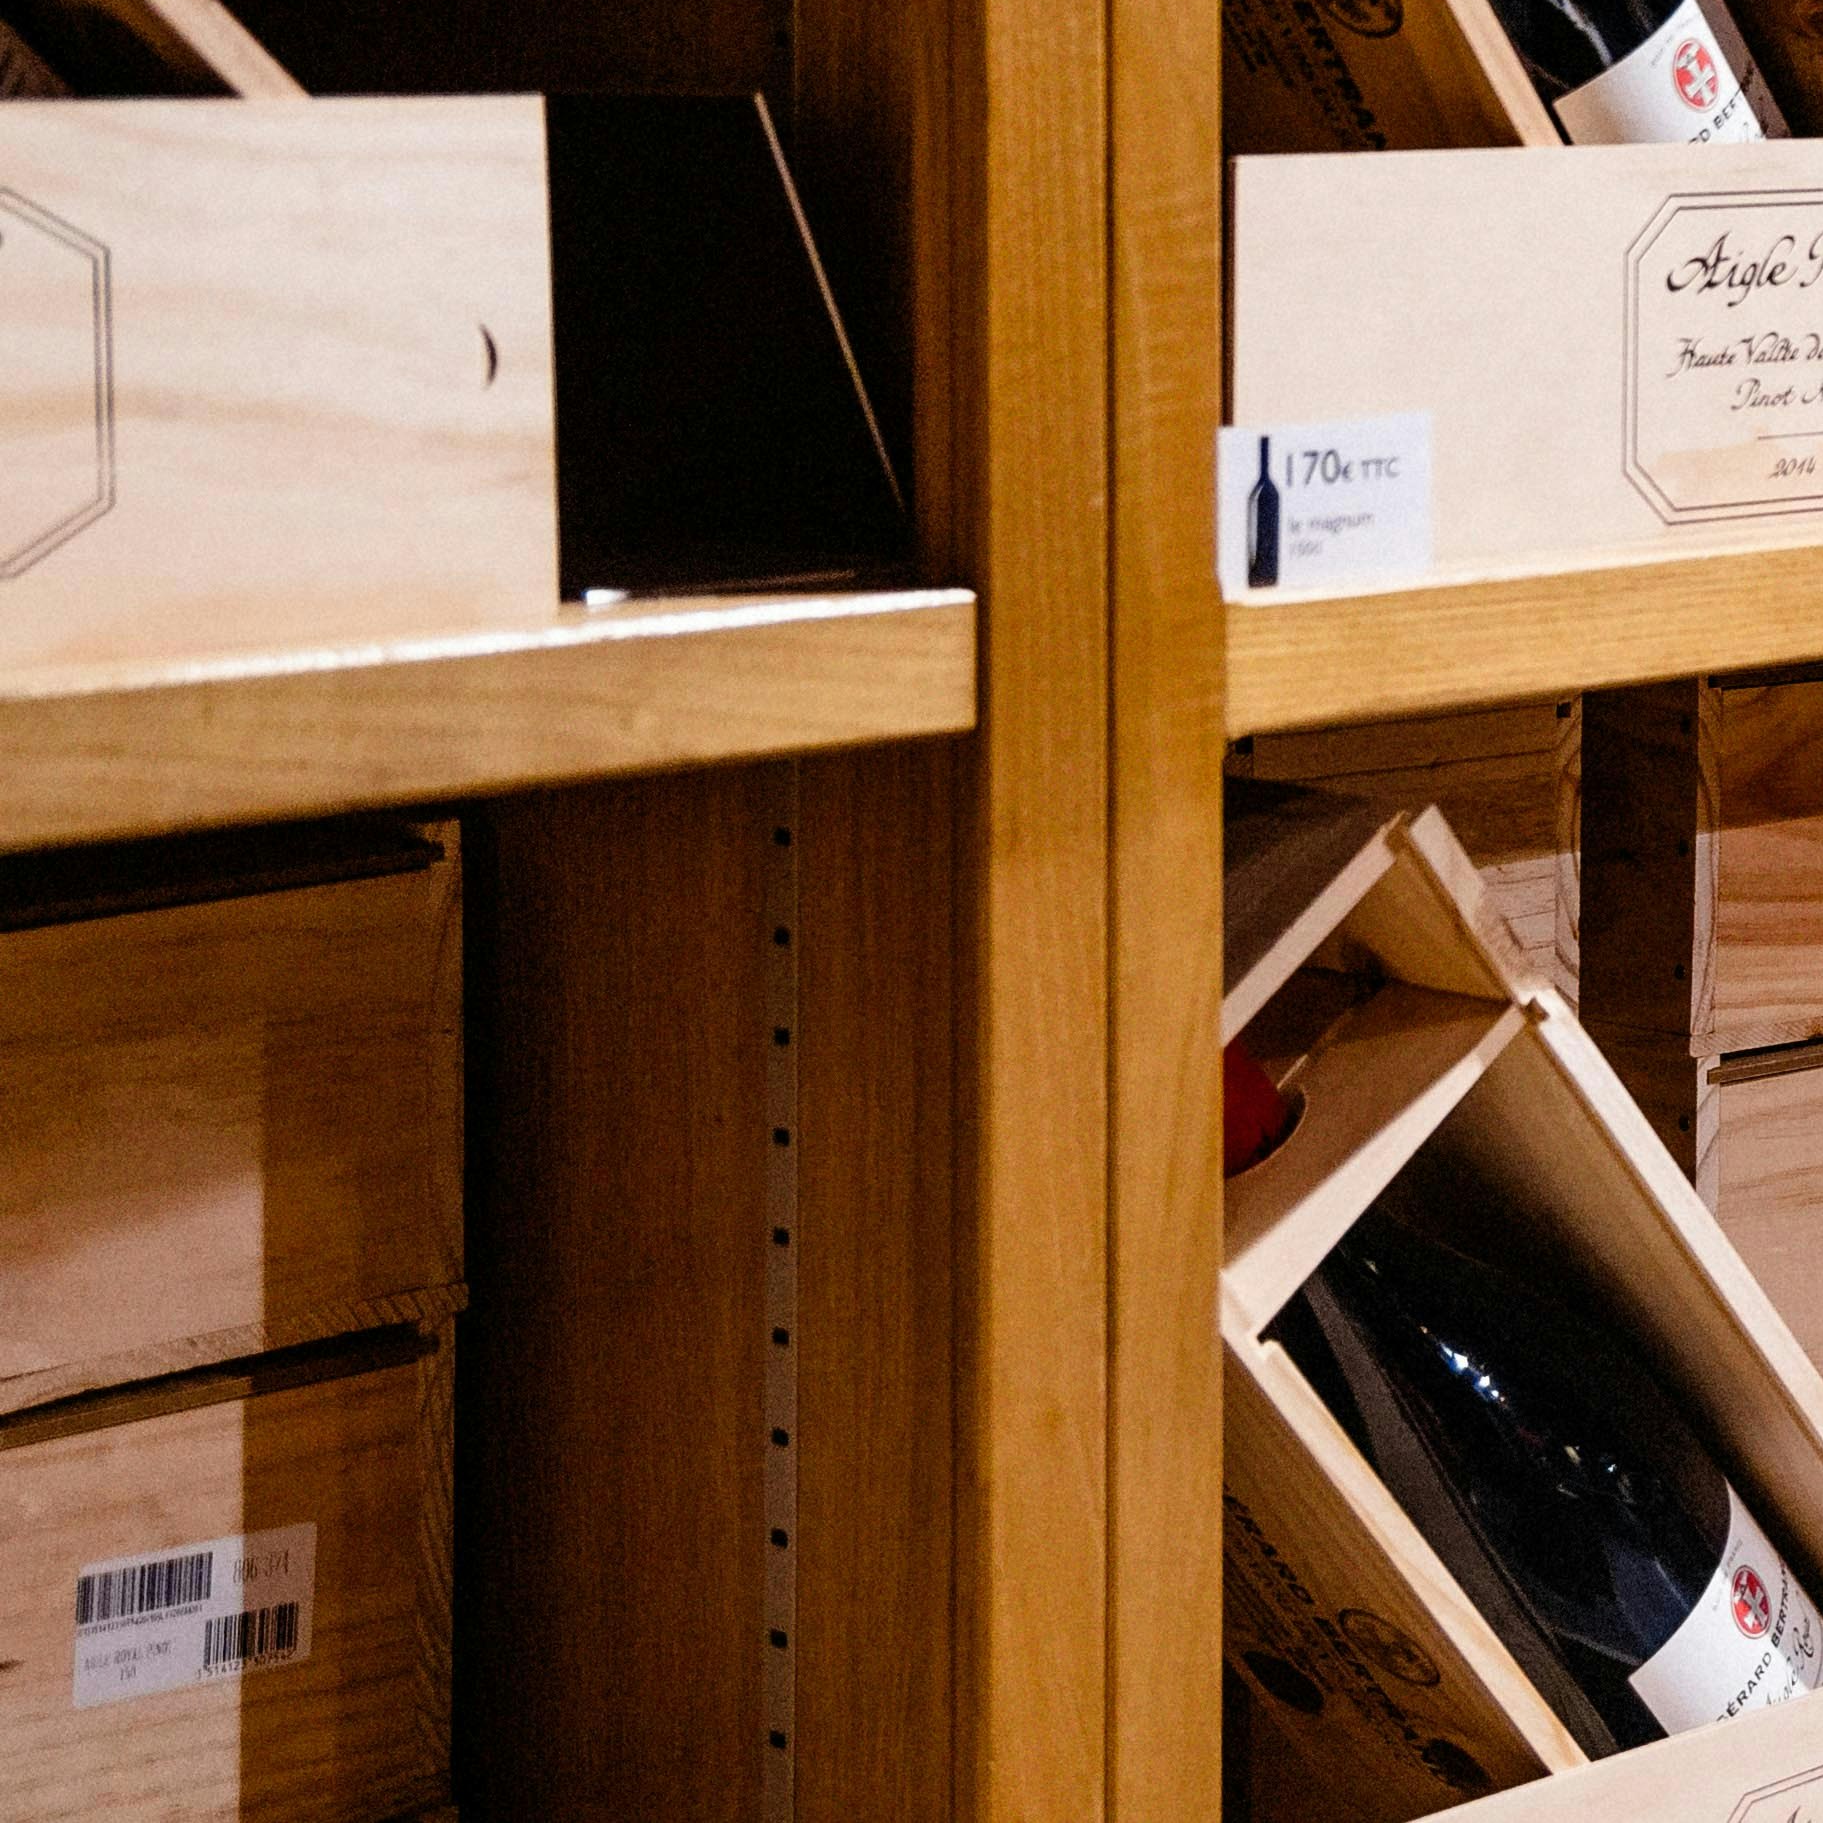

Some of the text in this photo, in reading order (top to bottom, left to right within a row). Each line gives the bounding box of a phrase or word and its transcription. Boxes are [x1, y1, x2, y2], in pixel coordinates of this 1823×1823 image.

[1666, 230, 1798, 308] Aigle
[1666, 336, 1738, 380] Haute
[1730, 377, 1796, 412] Pinot
[1285, 448, 1401, 489] 170€ TTC
[1767, 455, 1817, 481] 2014
